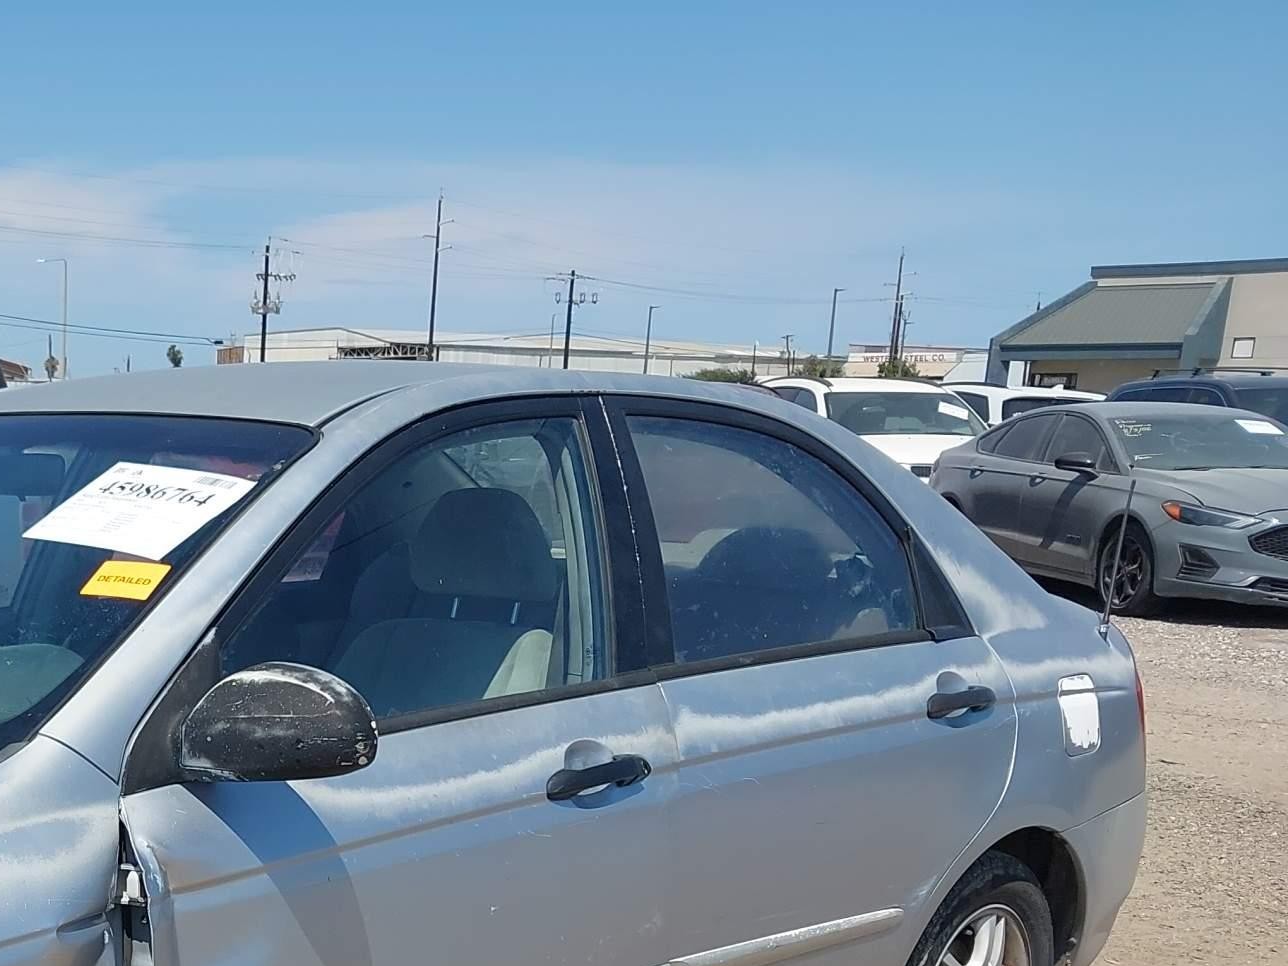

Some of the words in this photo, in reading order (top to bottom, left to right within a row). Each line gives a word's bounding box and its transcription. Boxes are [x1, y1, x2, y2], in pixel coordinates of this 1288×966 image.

[904, 354, 928, 363] STEEL
[98, 480, 216, 507] 45986764
[96, 574, 152, 586] DETAILED
